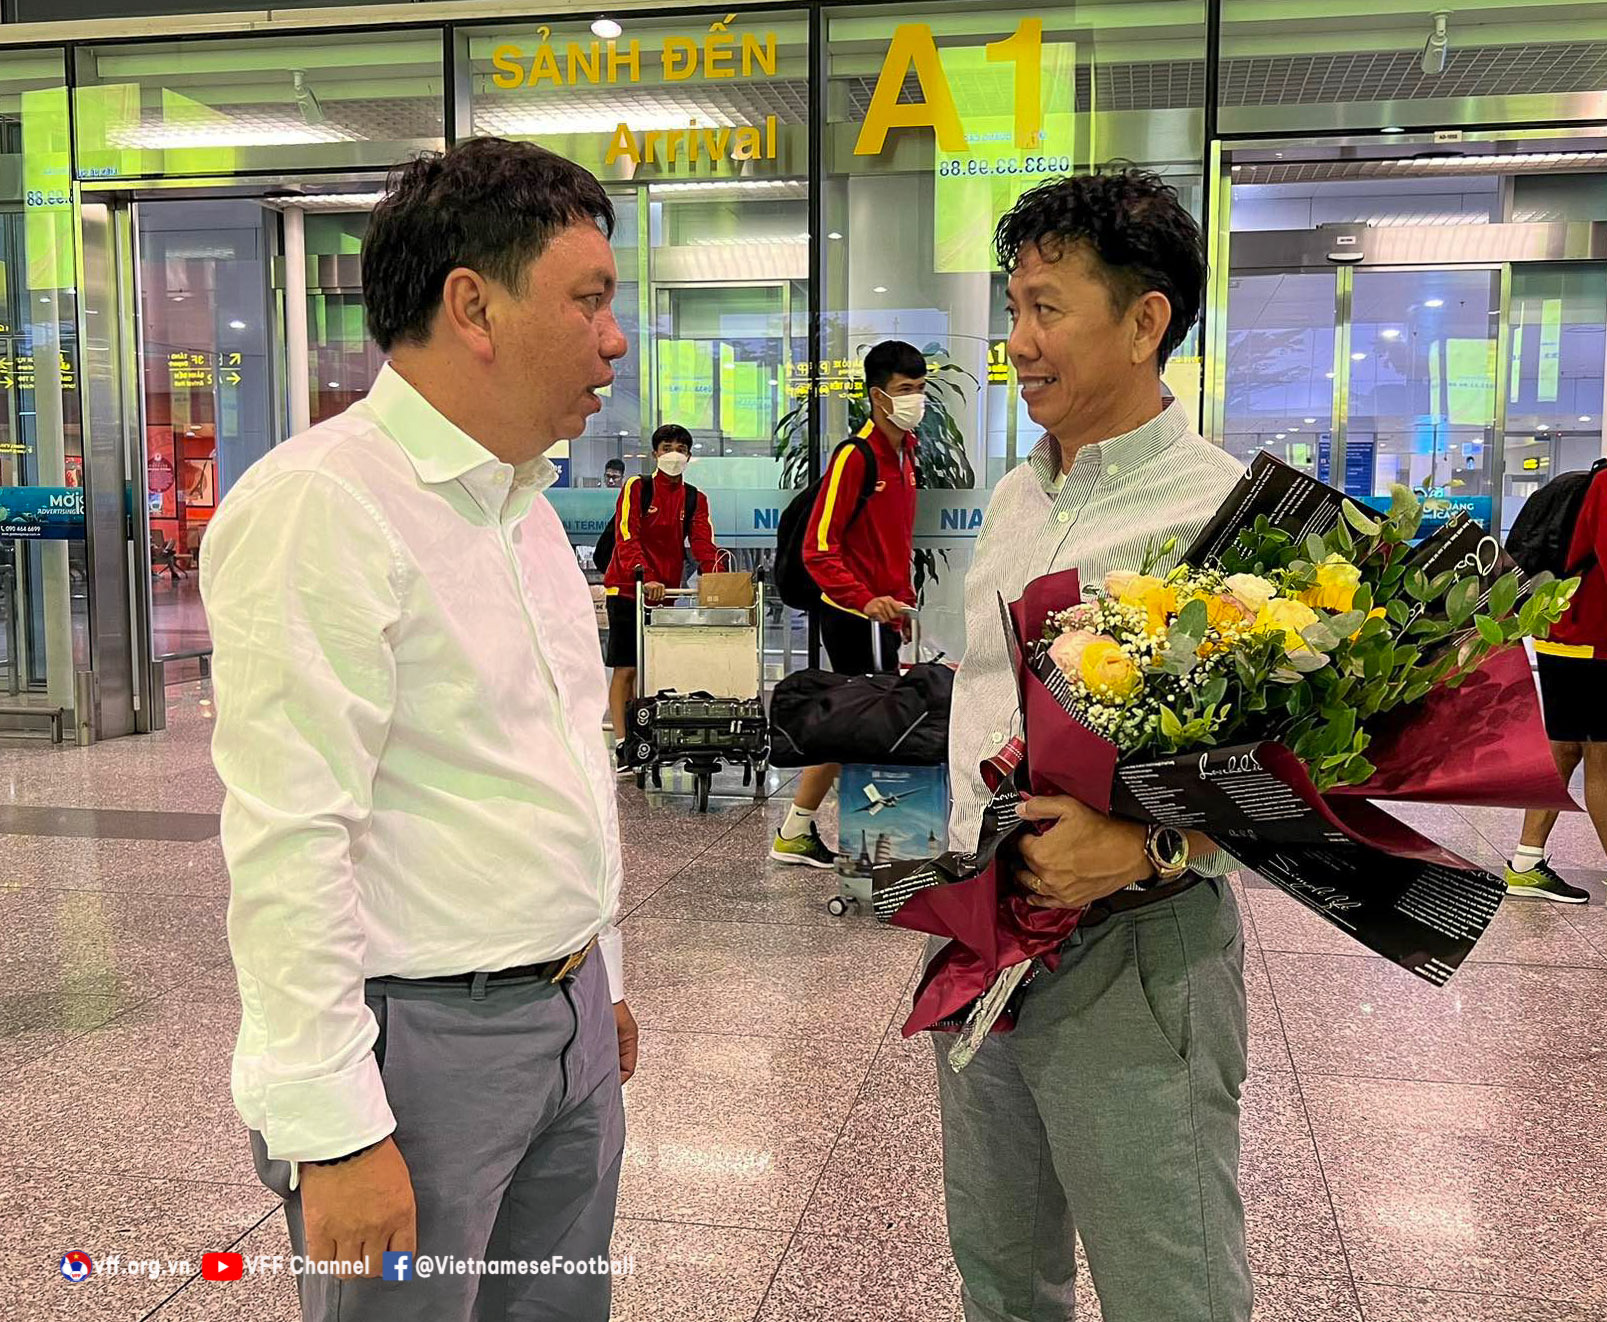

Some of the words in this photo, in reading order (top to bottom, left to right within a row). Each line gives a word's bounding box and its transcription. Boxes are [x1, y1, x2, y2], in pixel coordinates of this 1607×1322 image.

[492, 26, 640, 89] SẢNH
[661, 13, 777, 80] ĐẾN
[854, 18, 1042, 155] A1
[605, 114, 777, 165] Arrival
[754, 508, 779, 530] NI
